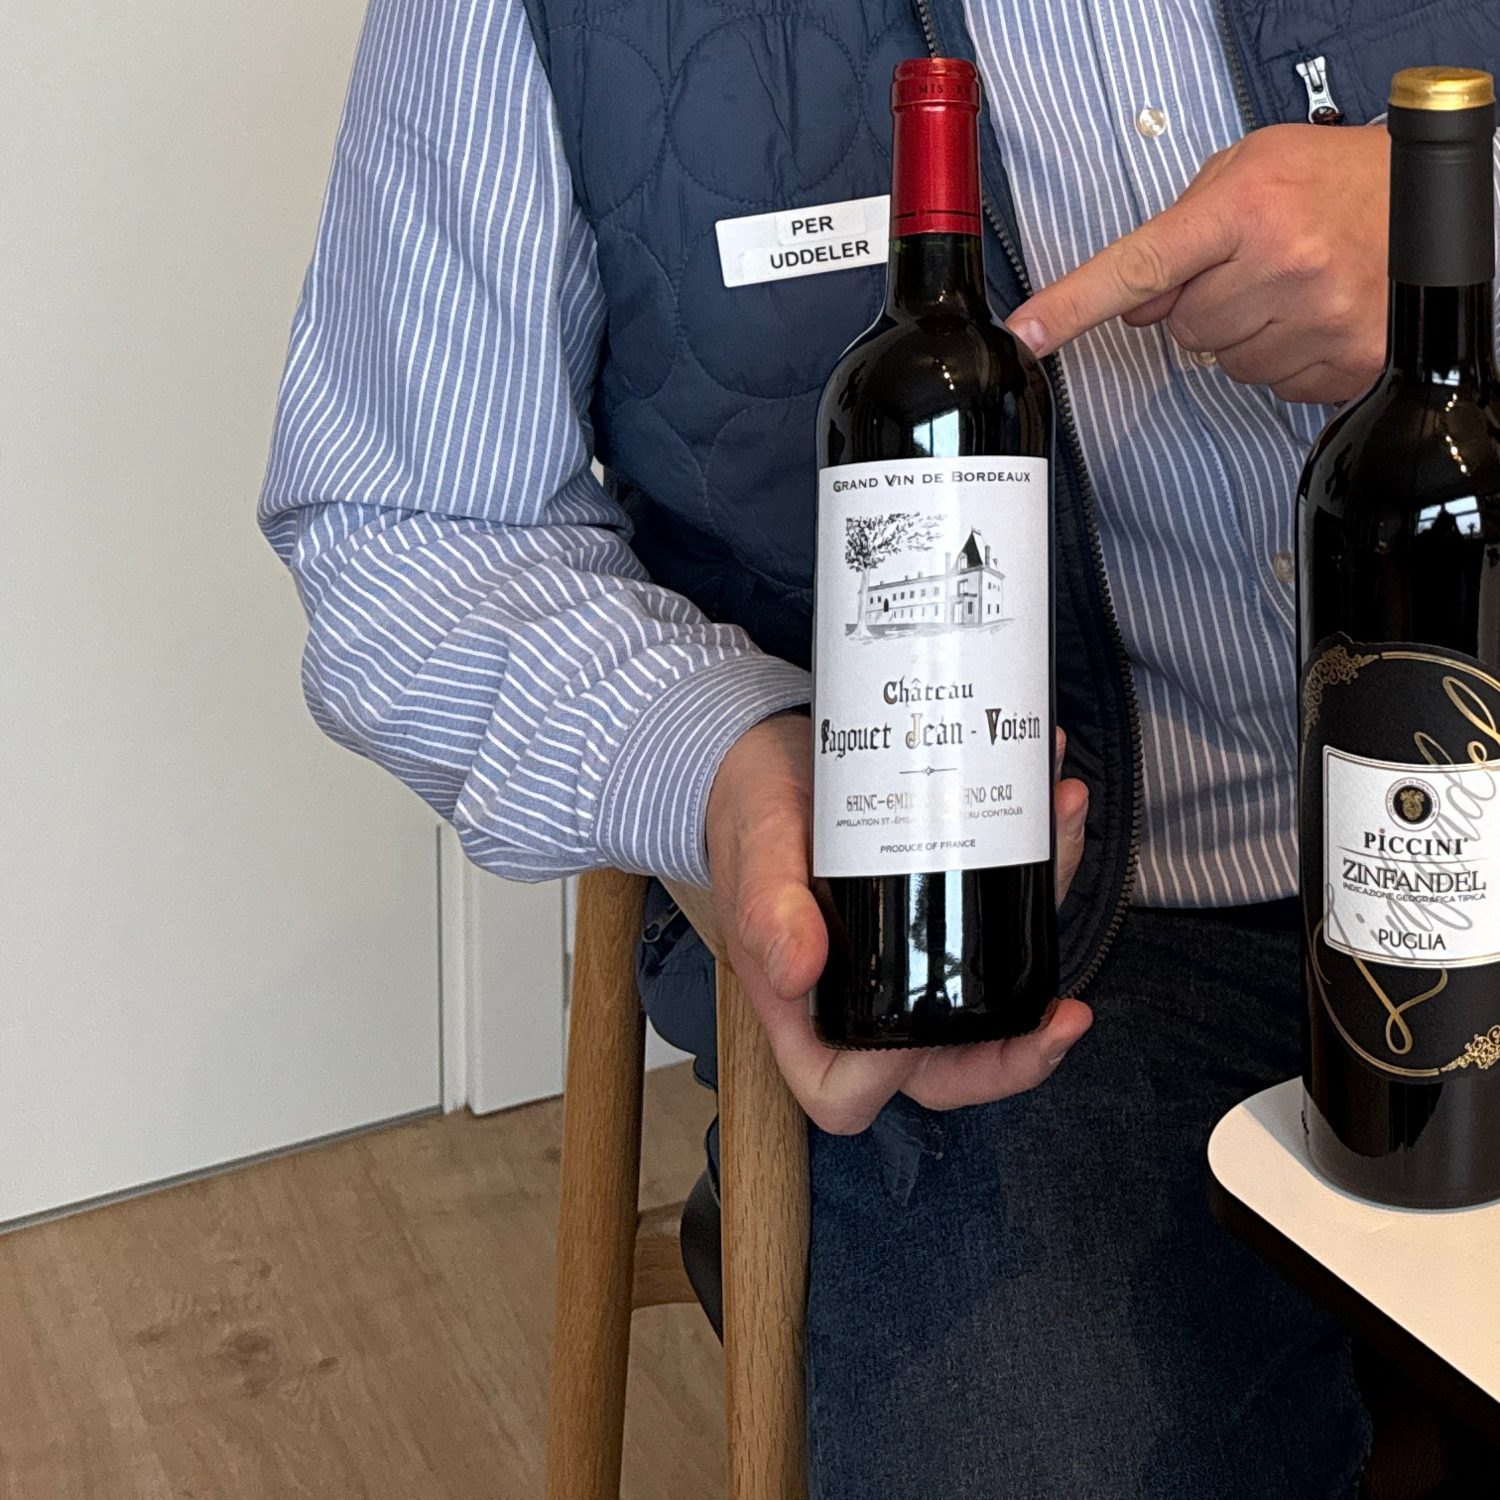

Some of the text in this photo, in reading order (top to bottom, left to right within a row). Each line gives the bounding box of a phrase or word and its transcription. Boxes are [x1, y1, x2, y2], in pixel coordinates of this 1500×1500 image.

[791, 215, 834, 236] PER
[770, 240, 870, 269] UDDELER
[833, 471, 1031, 492] GRAND VIN DE BORDEAUX
[883, 675, 974, 707] Château
[985, 708, 1041, 745] Voisin
[880, 839, 976, 854] PRODUCE OF FRANCE
[1342, 858, 1486, 893] ZINFANDEL
[1378, 928, 1447, 950] PUGLIA
